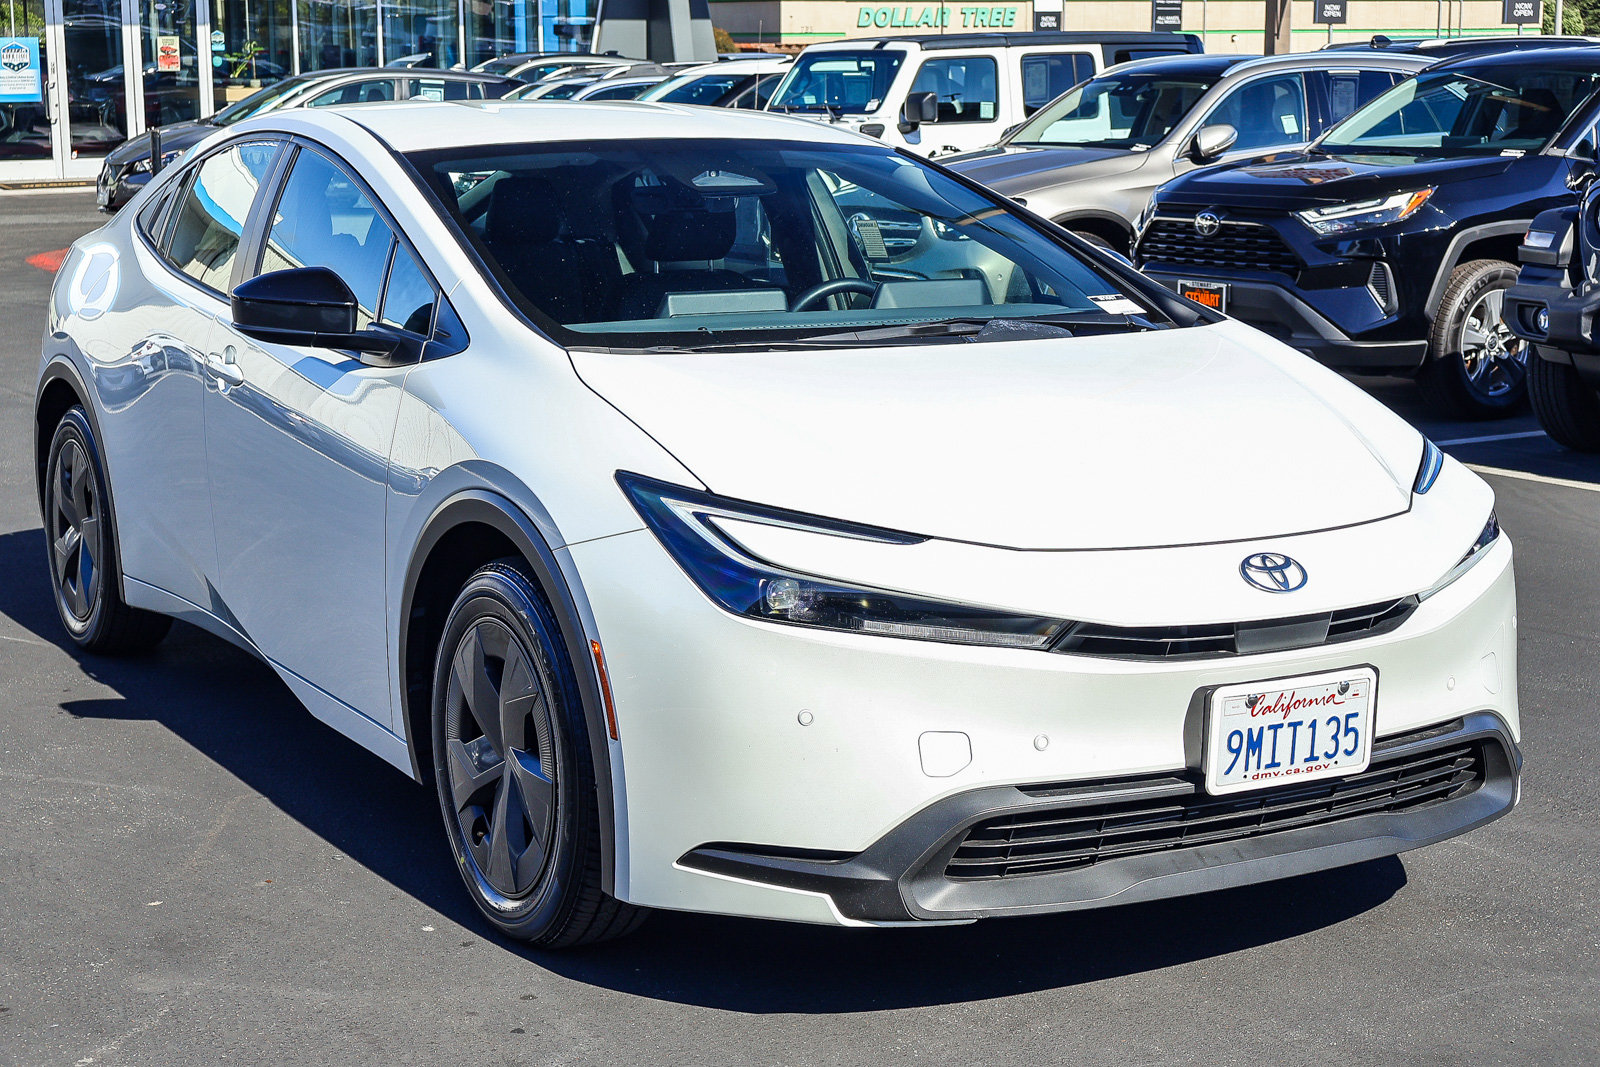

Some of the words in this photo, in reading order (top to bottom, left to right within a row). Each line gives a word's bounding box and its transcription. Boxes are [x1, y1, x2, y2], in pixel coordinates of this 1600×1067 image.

[857, 7, 950, 28] DOLLAR
[961, 7, 1017, 28] TREE
[1460, 274, 1490, 312] KELLY
[1251, 688, 1345, 720] California
[1224, 712, 1360, 776] 9MIT135
[1252, 763, 1331, 780] dmv.ca.gov
